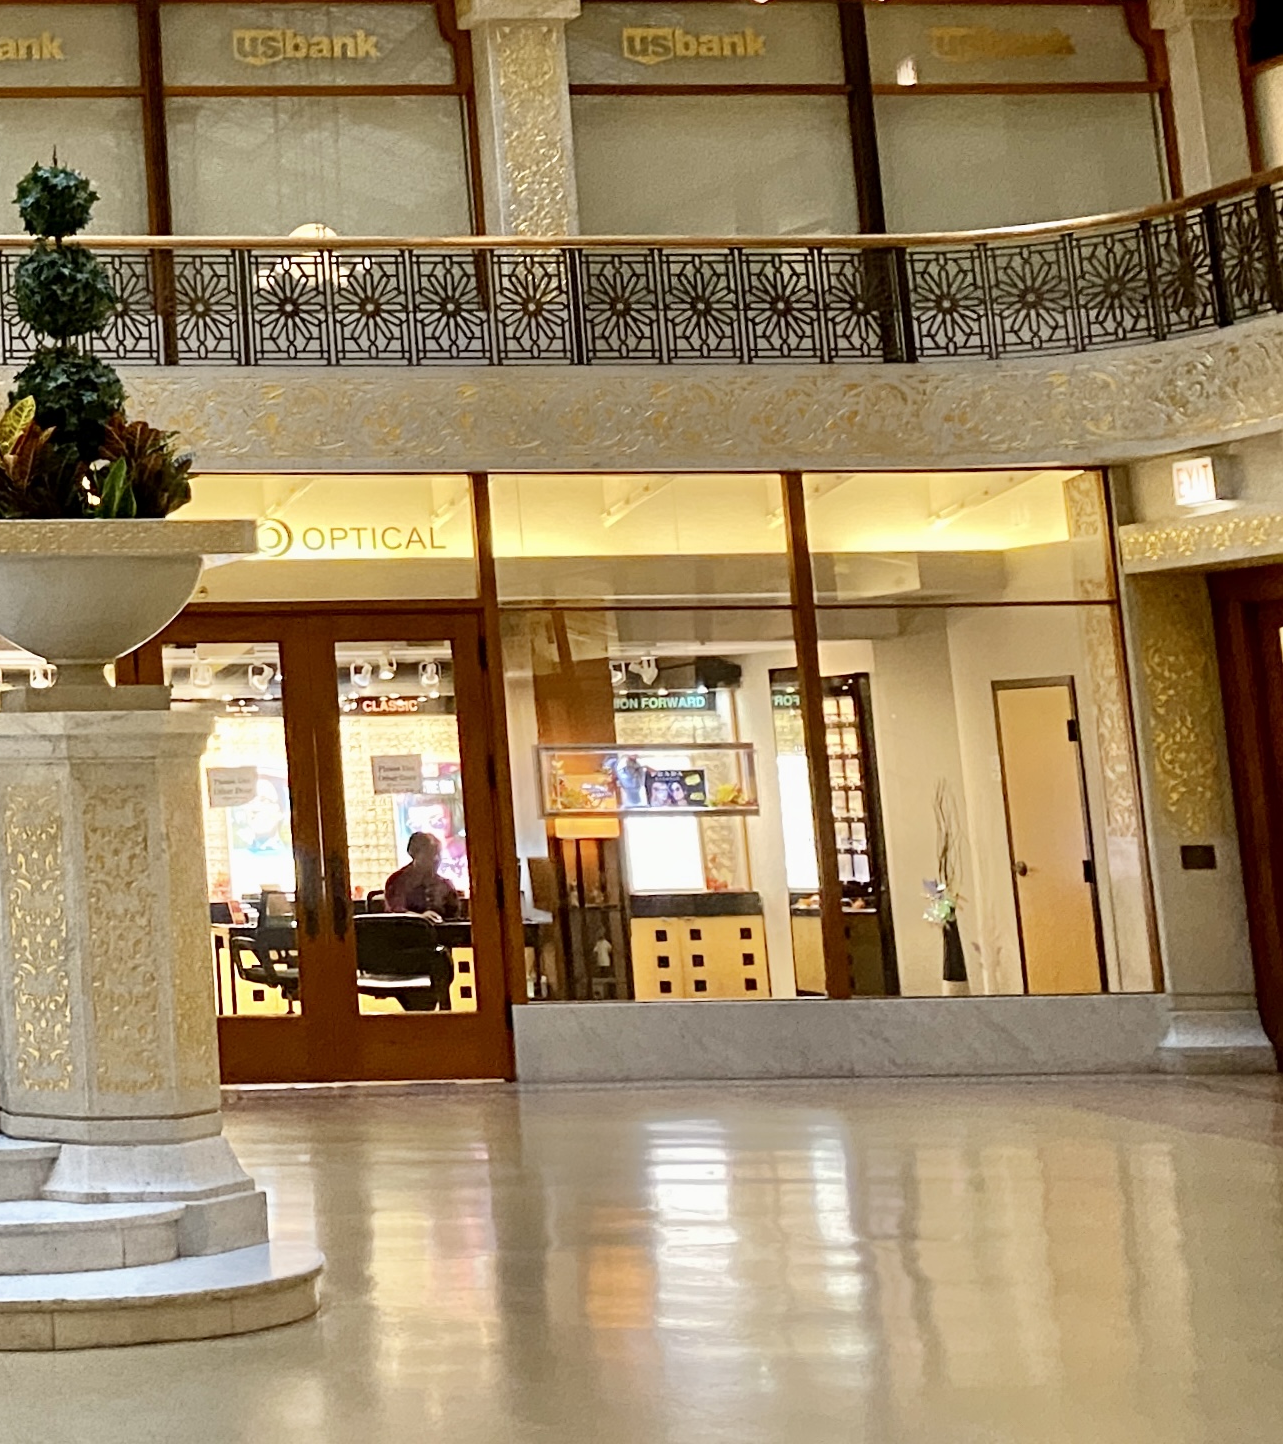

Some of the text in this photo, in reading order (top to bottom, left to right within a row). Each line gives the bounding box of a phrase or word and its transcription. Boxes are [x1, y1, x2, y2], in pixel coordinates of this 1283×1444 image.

[233, 28, 381, 65] usbank
[302, 526, 447, 550] OPTICAL
[362, 699, 418, 712] CLASSIC
[641, 696, 706, 709] FORWARD
